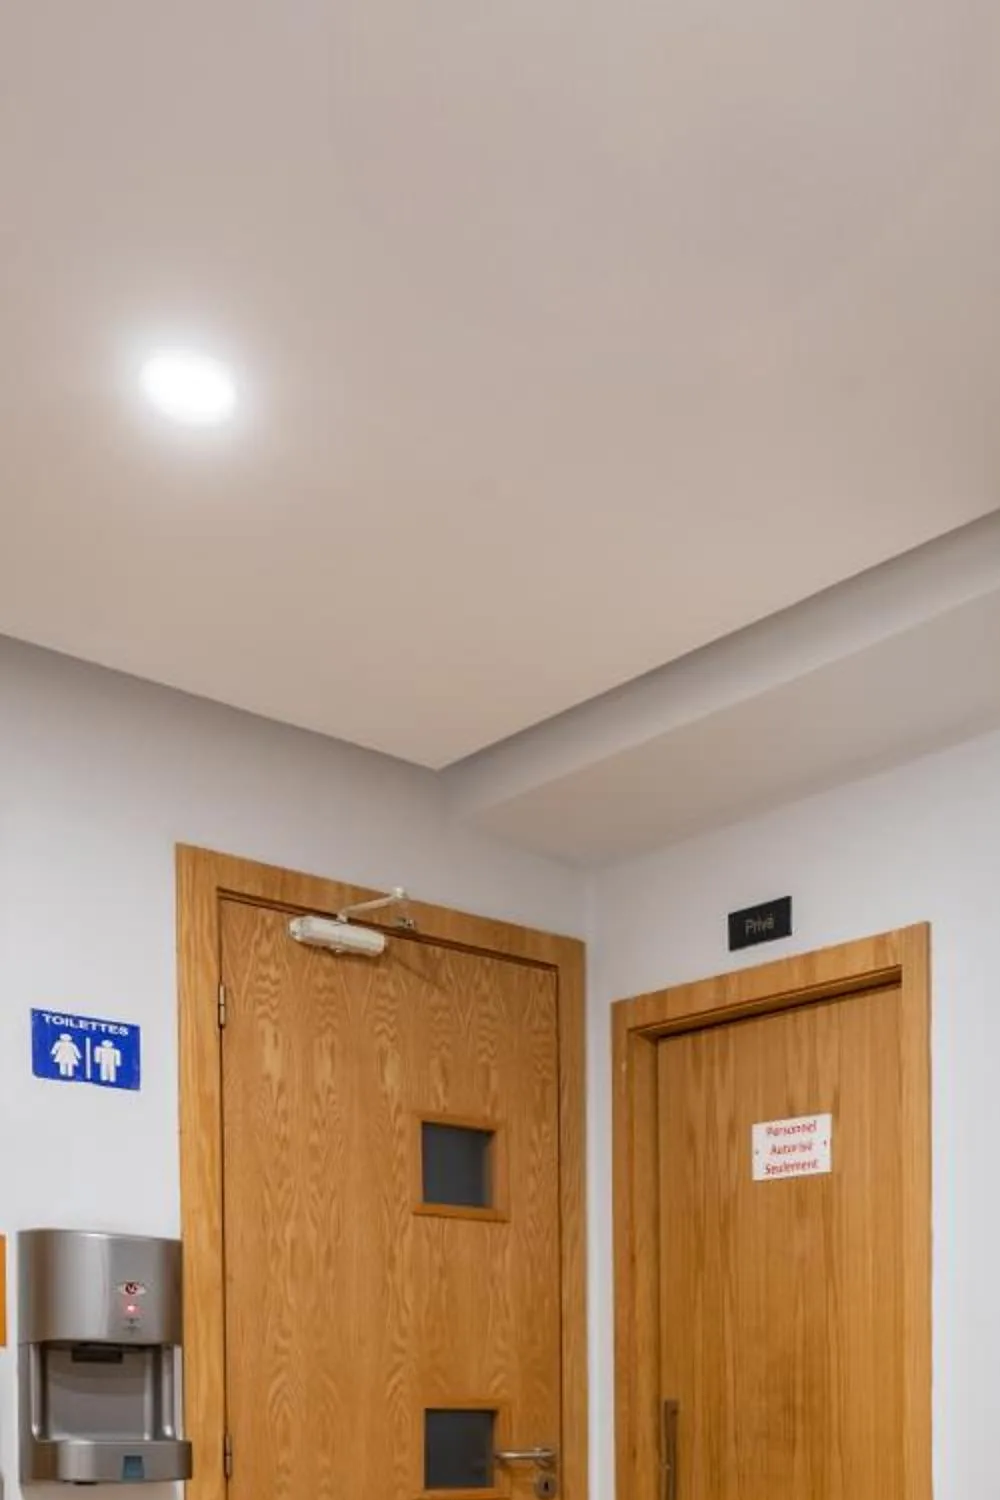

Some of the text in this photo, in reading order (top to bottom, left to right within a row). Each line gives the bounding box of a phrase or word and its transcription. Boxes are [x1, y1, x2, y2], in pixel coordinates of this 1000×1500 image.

[42, 1014, 128, 1036] TOILETTES
[766, 1120, 817, 1136] Personnel
[766, 1159, 818, 1175] Seulement
